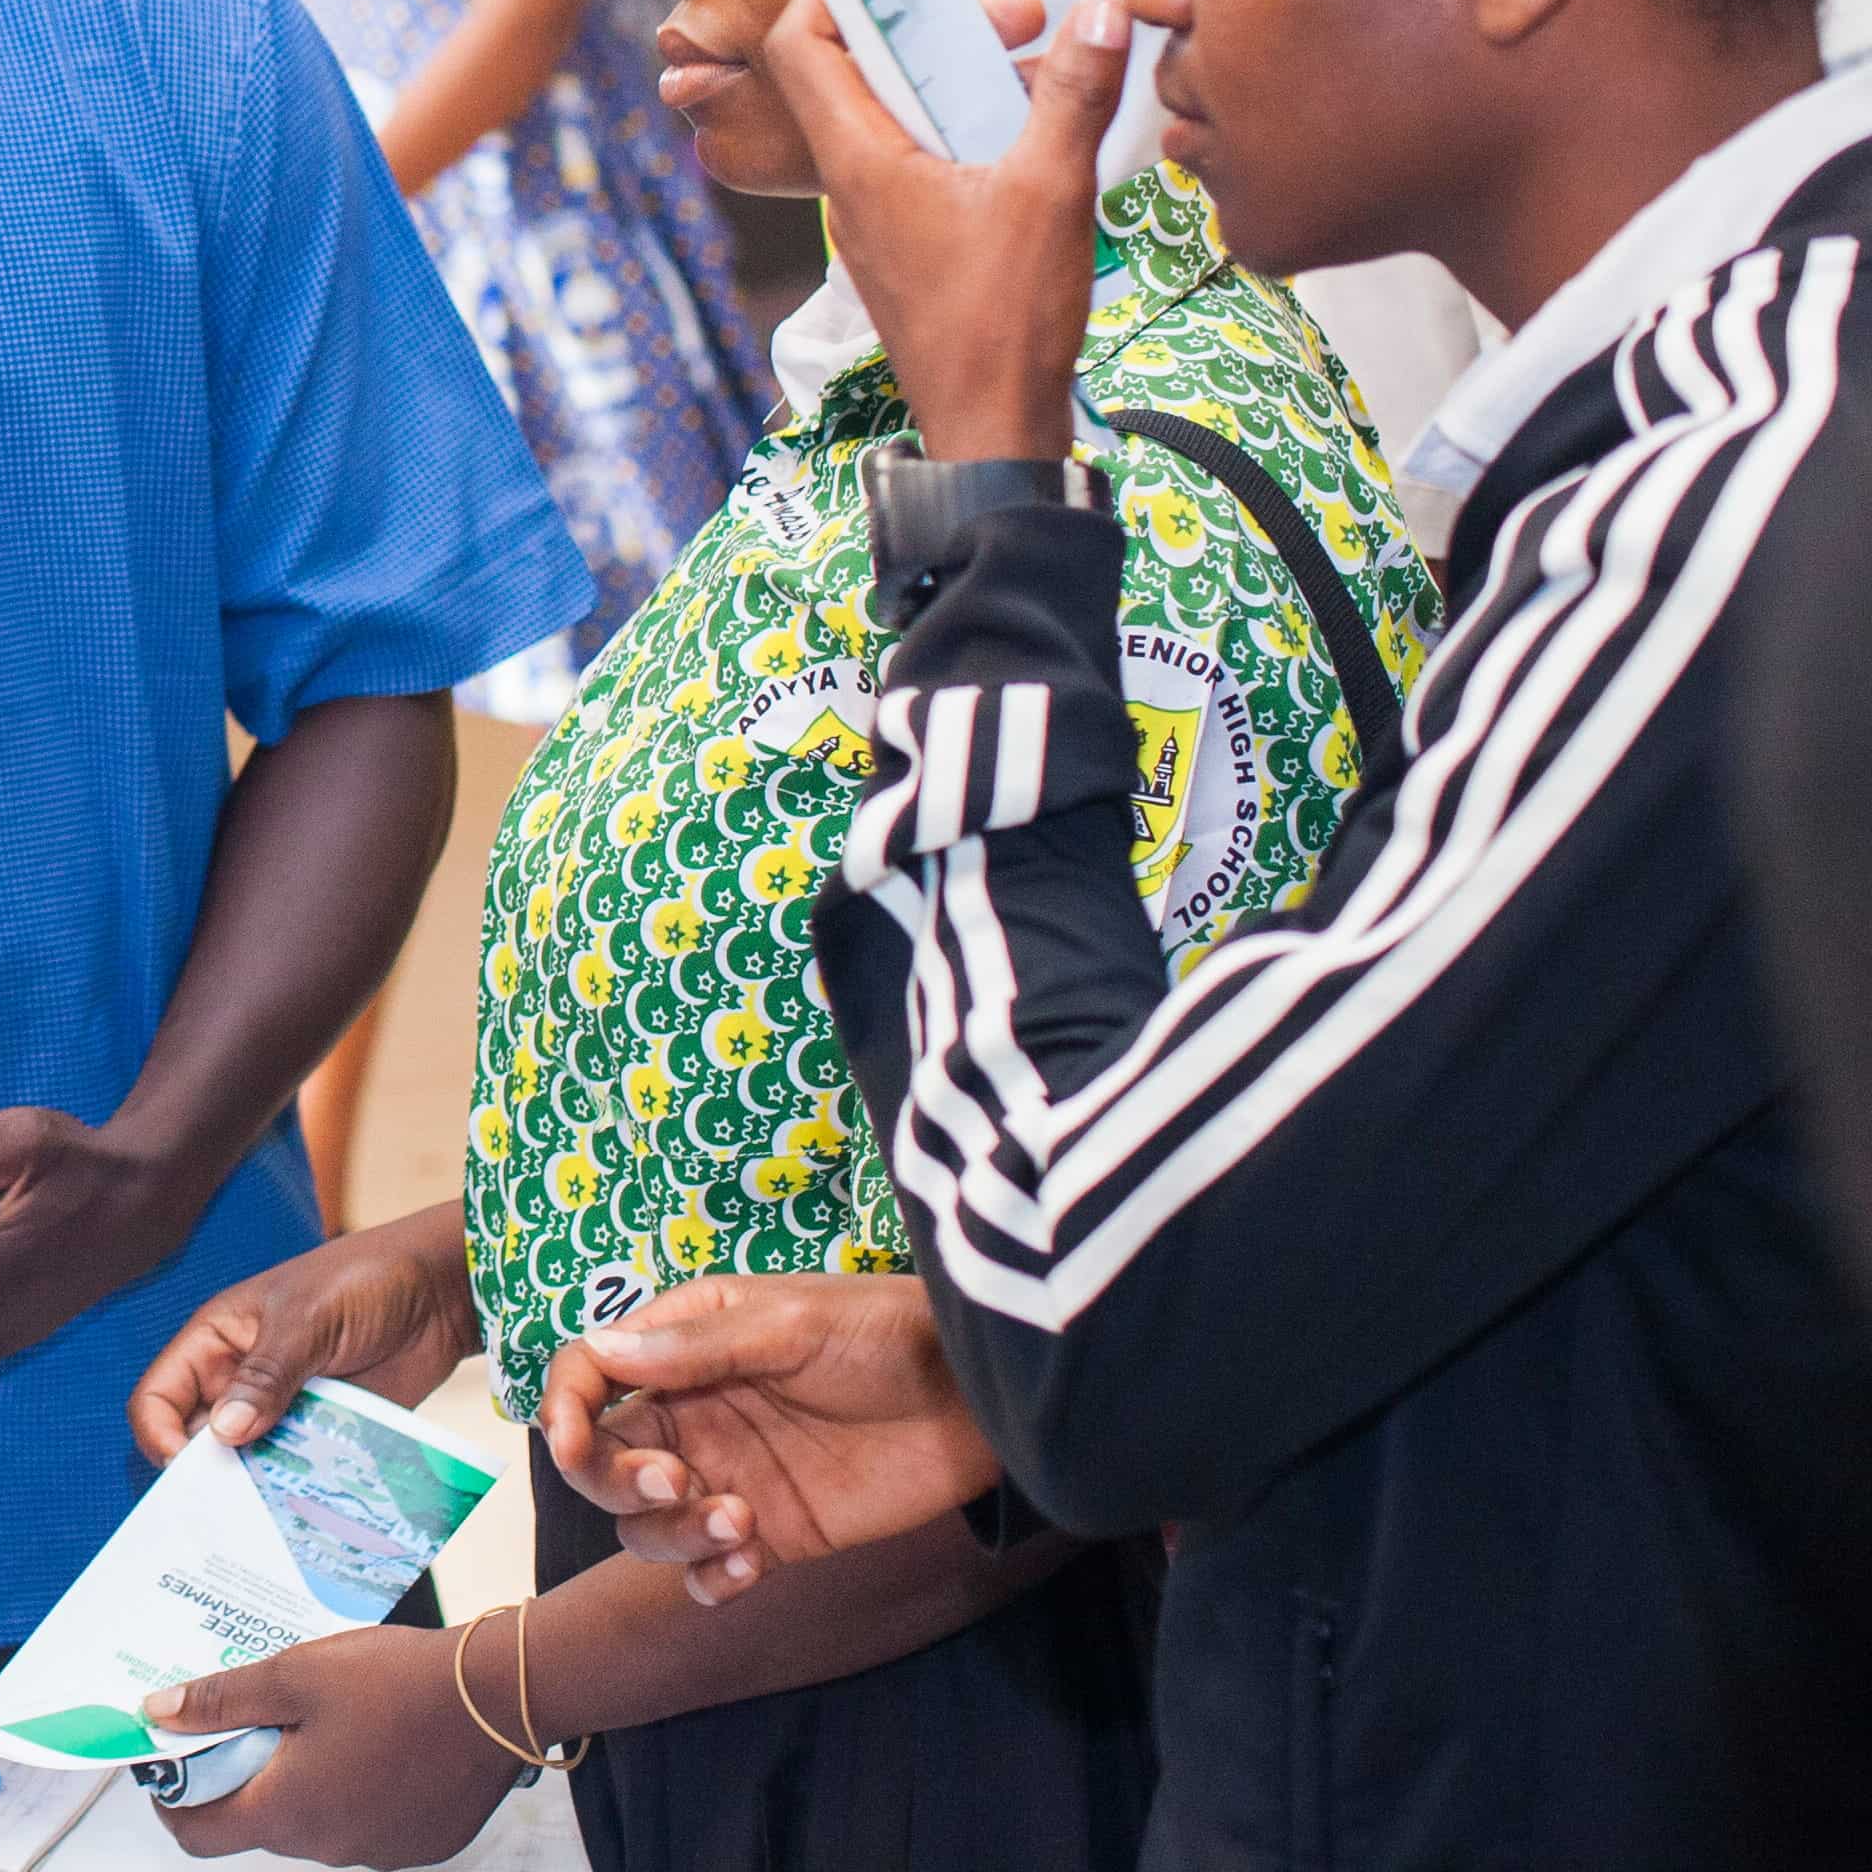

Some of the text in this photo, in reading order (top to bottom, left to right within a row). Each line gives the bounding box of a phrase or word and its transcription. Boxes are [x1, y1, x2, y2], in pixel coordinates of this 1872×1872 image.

[1116, 633, 1225, 692] ENIOR
[1217, 692, 1257, 786] HIGH
[1172, 798, 1257, 930] SCHOOL
[158, 1572, 303, 1646] ROGRAMMES
[199, 1613, 285, 1657] EGREE
